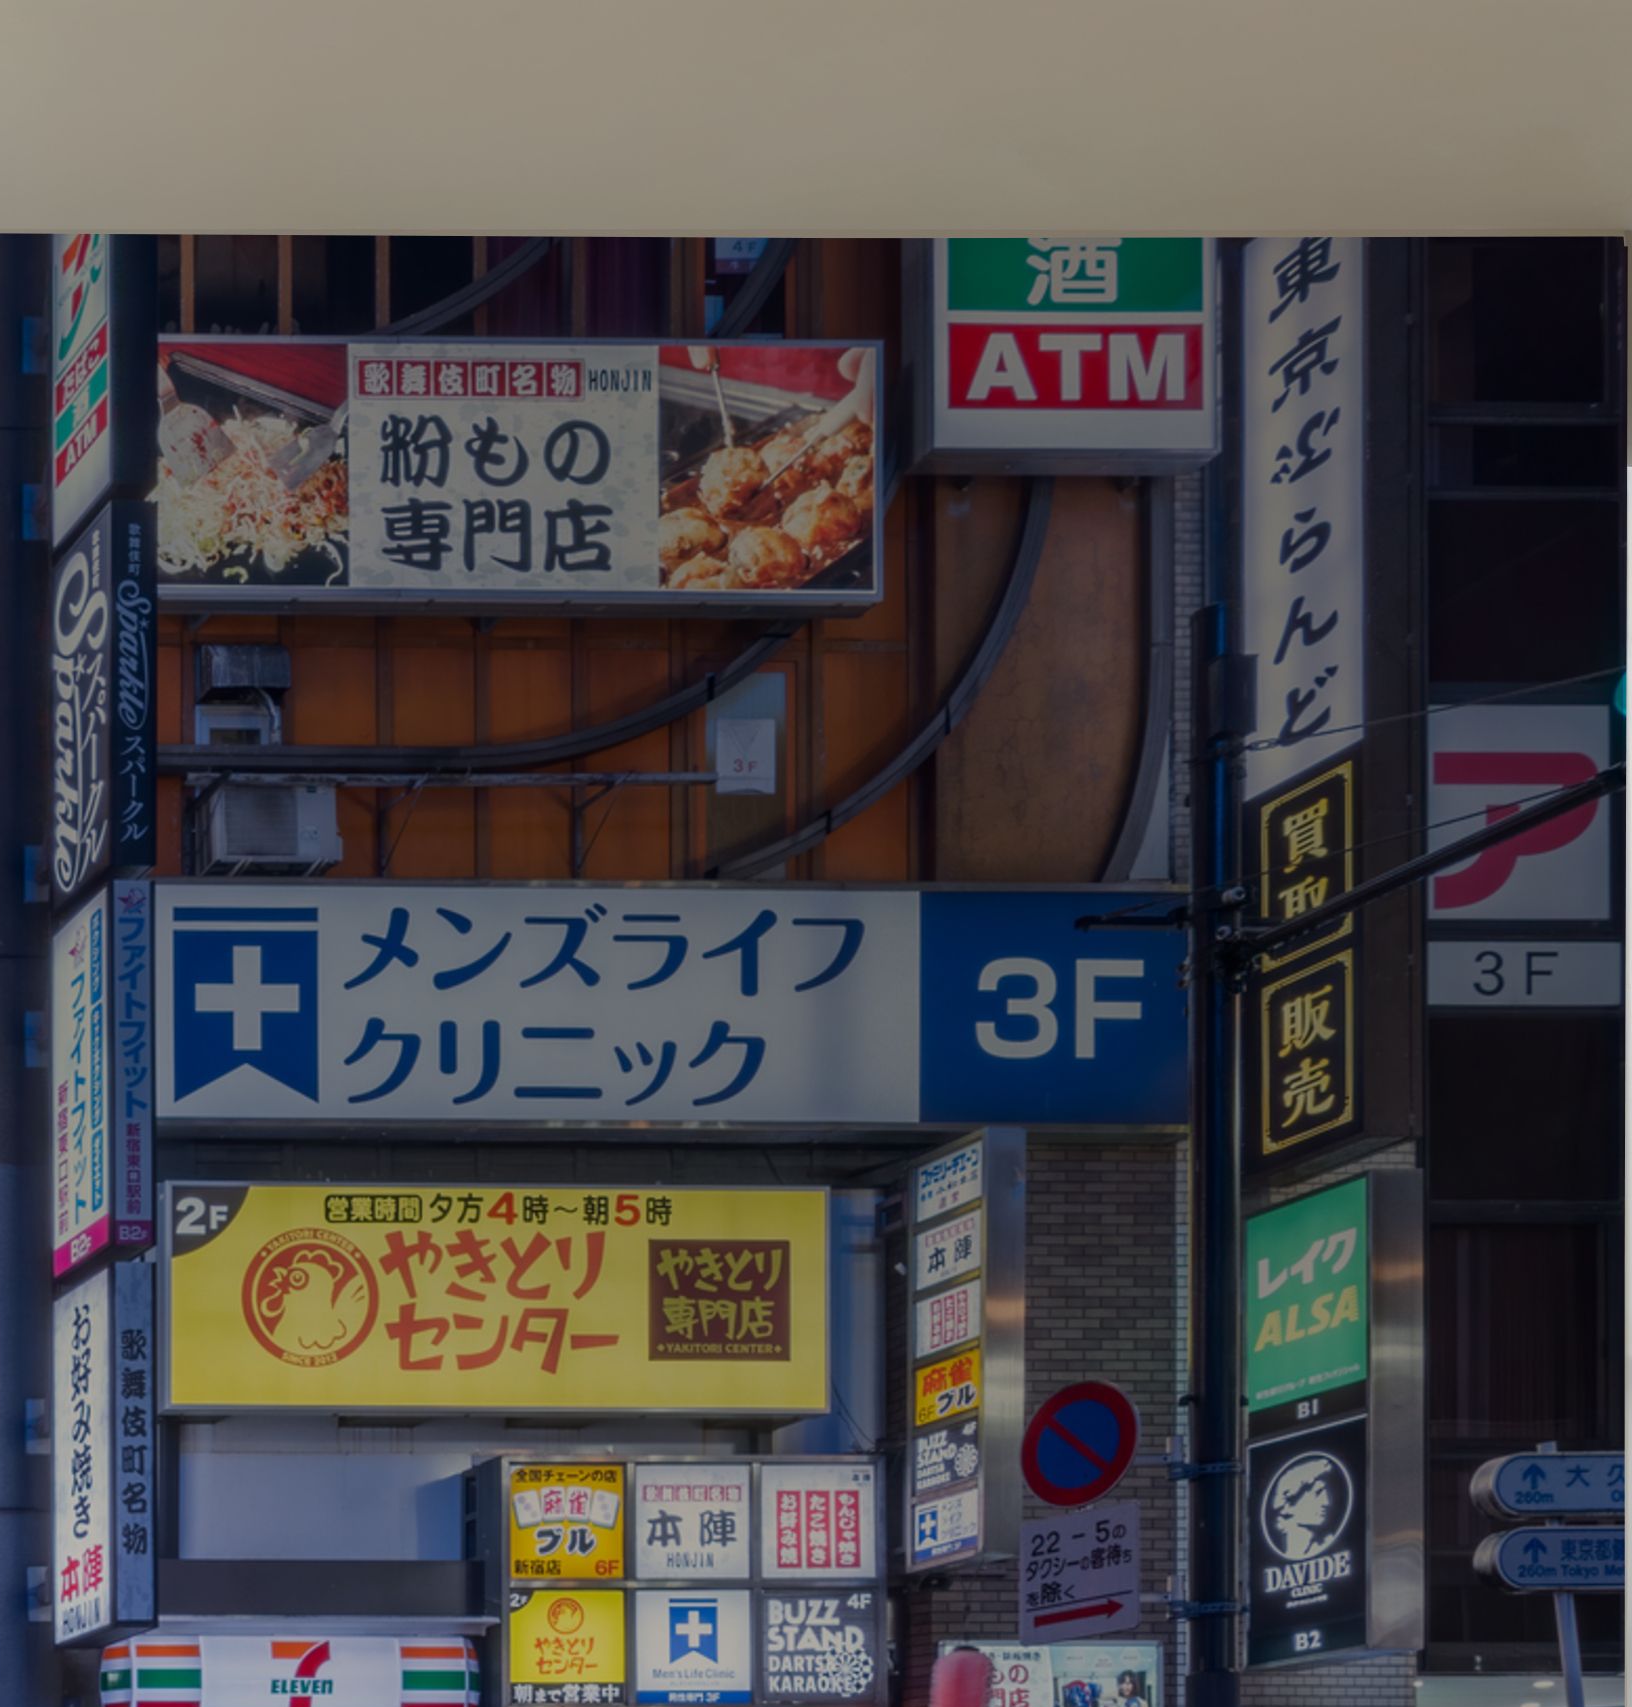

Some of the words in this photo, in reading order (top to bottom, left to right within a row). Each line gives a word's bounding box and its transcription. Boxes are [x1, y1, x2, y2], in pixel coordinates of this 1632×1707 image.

[1025, 238, 1123, 306] 酒
[363, 362, 581, 397] 歌舞伎町名物
[588, 369, 653, 393] HONJIN
[965, 331, 1188, 402] ATM
[64, 411, 98, 473] ATM
[380, 413, 612, 488] 粉もの
[380, 497, 614, 573] 専門店
[116, 578, 152, 731] Sparkle
[53, 552, 108, 893] Sparkle
[79, 652, 109, 882] スパークル
[733, 758, 758, 773] 3F
[119, 735, 150, 843] スパークル
[1277, 797, 1330, 921] 買取
[344, 903, 865, 997] メンズライフ
[1472, 951, 1559, 997] 3F
[118, 916, 148, 1119] ファイトフィット
[975, 957, 1145, 1060] 3F
[344, 1017, 766, 1107] クリニック
[1278, 983, 1337, 1129] 販売
[70, 970, 88, 1226] ファイトフィット
[175, 1196, 229, 1236] 2F
[325, 1195, 423, 1224] 営業時間
[118, 1224, 148, 1244] B2F
[928, 1234, 973, 1275] 本陣
[379, 1228, 607, 1302] やきとり
[656, 1246, 784, 1292] やきとり
[1256, 1227, 1358, 1300] レイク
[385, 1303, 620, 1375] センター
[662, 1296, 775, 1341] 専門店
[1253, 1284, 1360, 1354] ALSA
[666, 1342, 723, 1354] YAKITORI
[724, 1342, 774, 1354] CENTER
[922, 1356, 973, 1397] 麻雀
[937, 1383, 976, 1415] ブル
[1296, 1398, 1320, 1420] B1
[69, 1303, 93, 1540] お好み焼き
[917, 1430, 948, 1449] BUZZ
[120, 1328, 149, 1557] 歌舞伎町名物
[516, 1470, 618, 1484] 全国チェーンの店
[543, 1487, 589, 1517] 麻雀
[536, 1527, 595, 1555] ブル
[647, 1509, 738, 1547] 本陣
[60, 1543, 104, 1602] 本陣
[514, 1560, 562, 1576] 新宿店
[595, 1560, 620, 1576] 6F
[666, 1552, 715, 1568] HONJIN
[1025, 1543, 1133, 1582] タクシーの客待ち
[1264, 1550, 1352, 1594] DAVIDE
[1518, 1565, 1557, 1578] 260m
[1562, 1564, 1599, 1579] Tokyo
[768, 1598, 841, 1626] BUZZ
[846, 1593, 872, 1609] 4F
[1026, 1581, 1076, 1606] を除く
[61, 1597, 102, 1637] HONJIN
[534, 1635, 596, 1657] やきとり
[767, 1625, 865, 1653] STAND
[1294, 1629, 1322, 1652] B2
[536, 1655, 599, 1676] センター
[685, 1667, 705, 1679] Life
[706, 1667, 736, 1680] Clinic
[513, 1684, 620, 1704] 朝まで営業中
